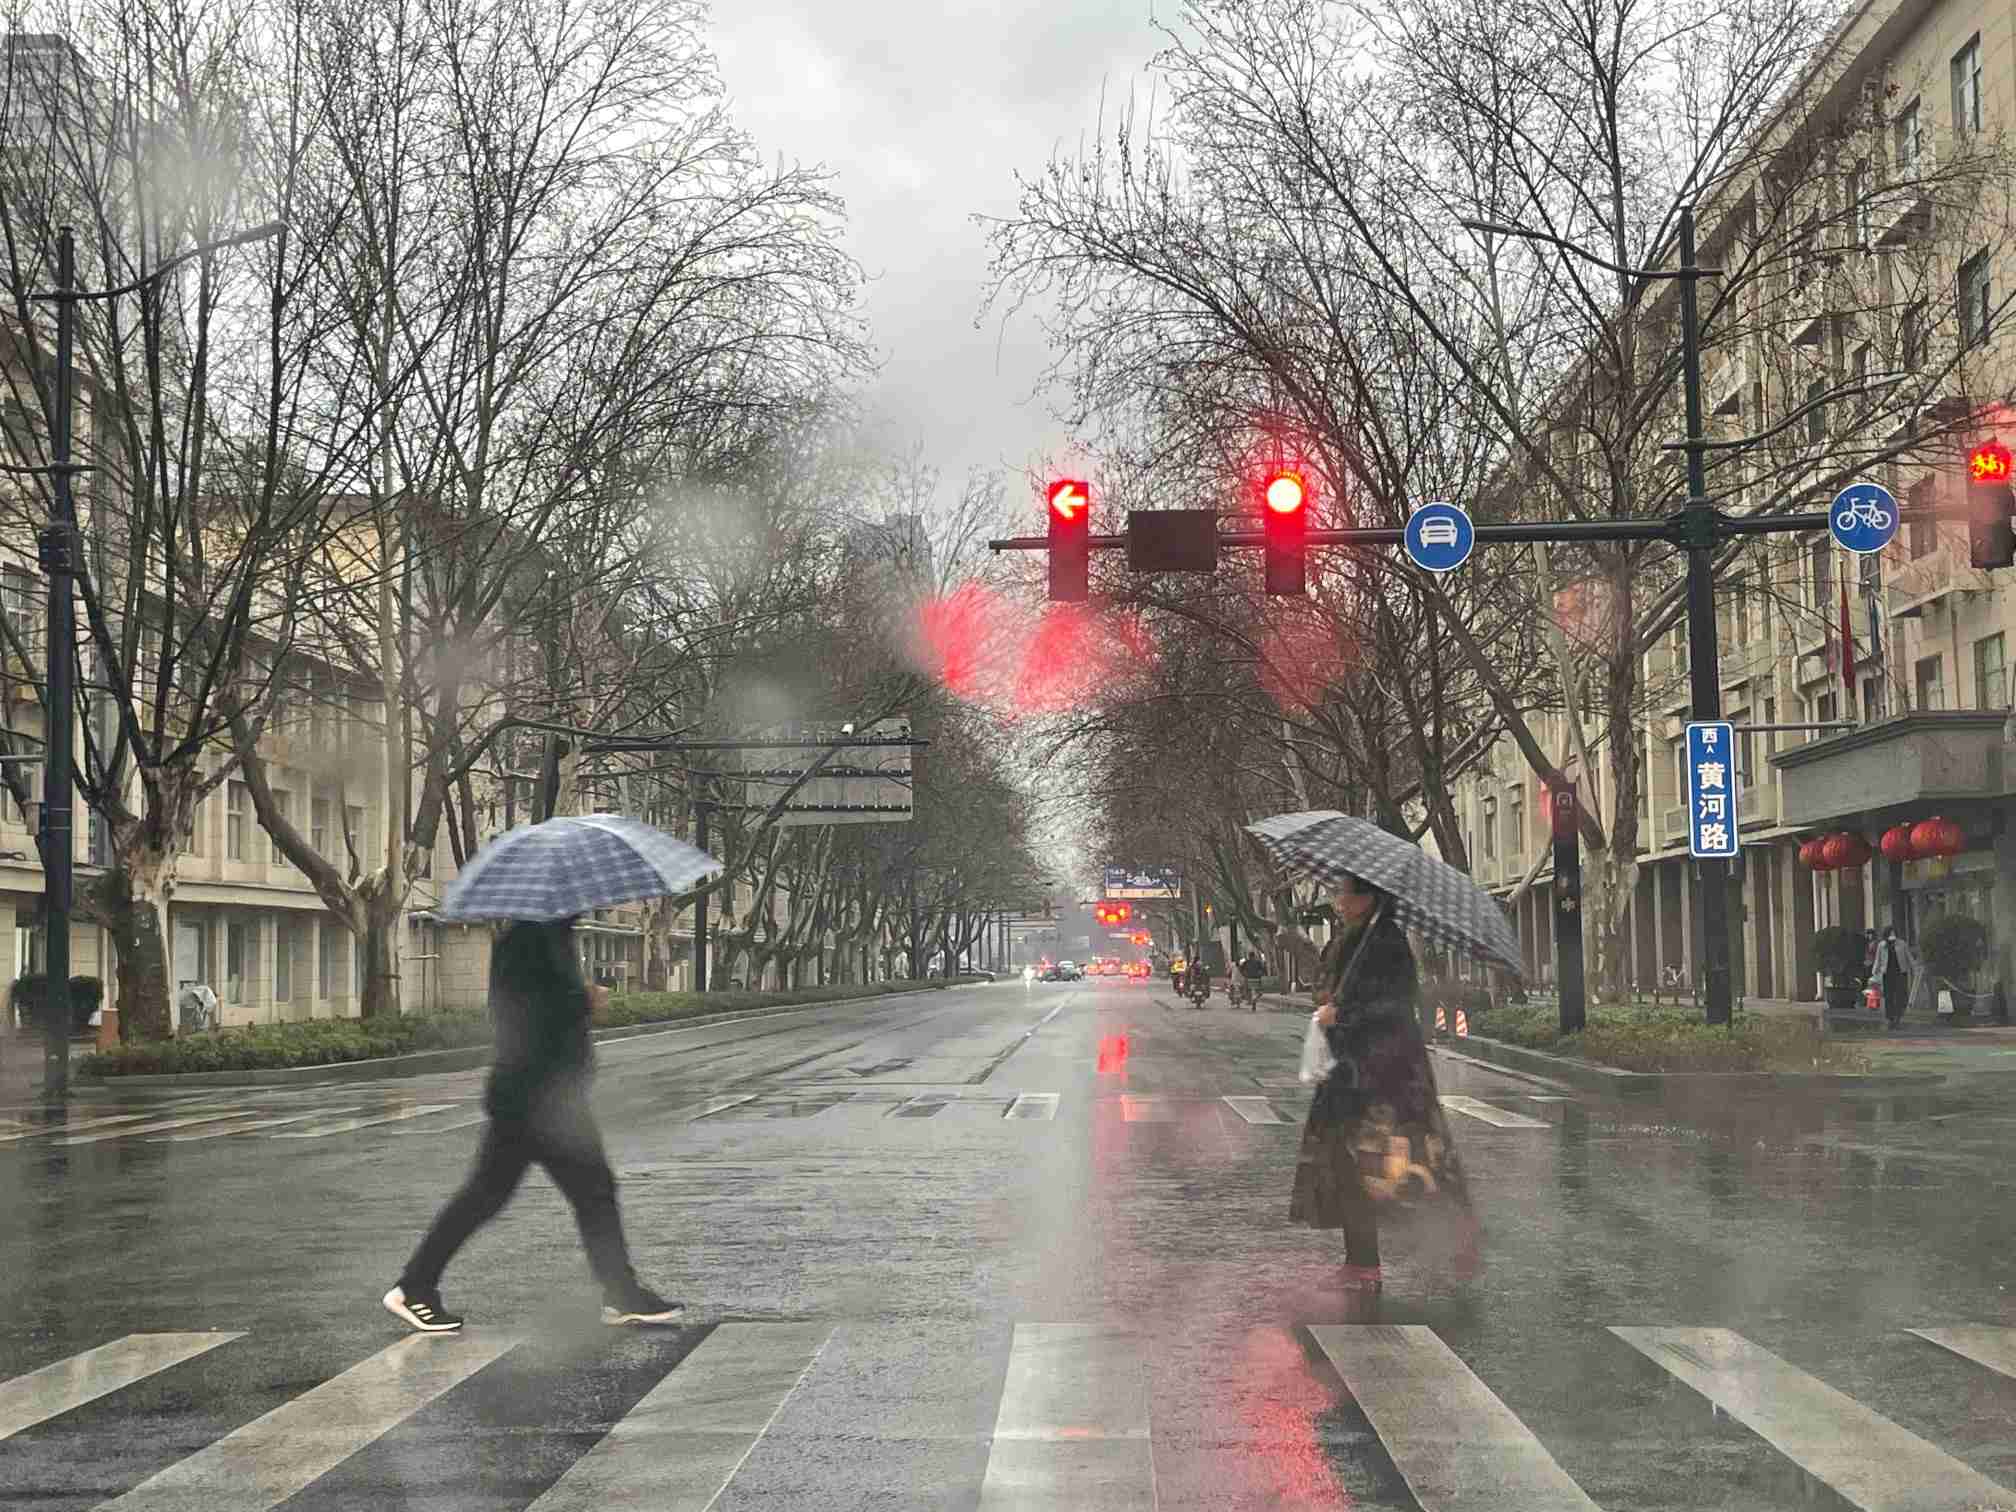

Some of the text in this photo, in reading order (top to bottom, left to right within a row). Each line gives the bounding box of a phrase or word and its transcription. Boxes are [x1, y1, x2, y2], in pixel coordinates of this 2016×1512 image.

[1701, 728, 1718, 744] 西
[1697, 762, 1728, 850] 黄河路
